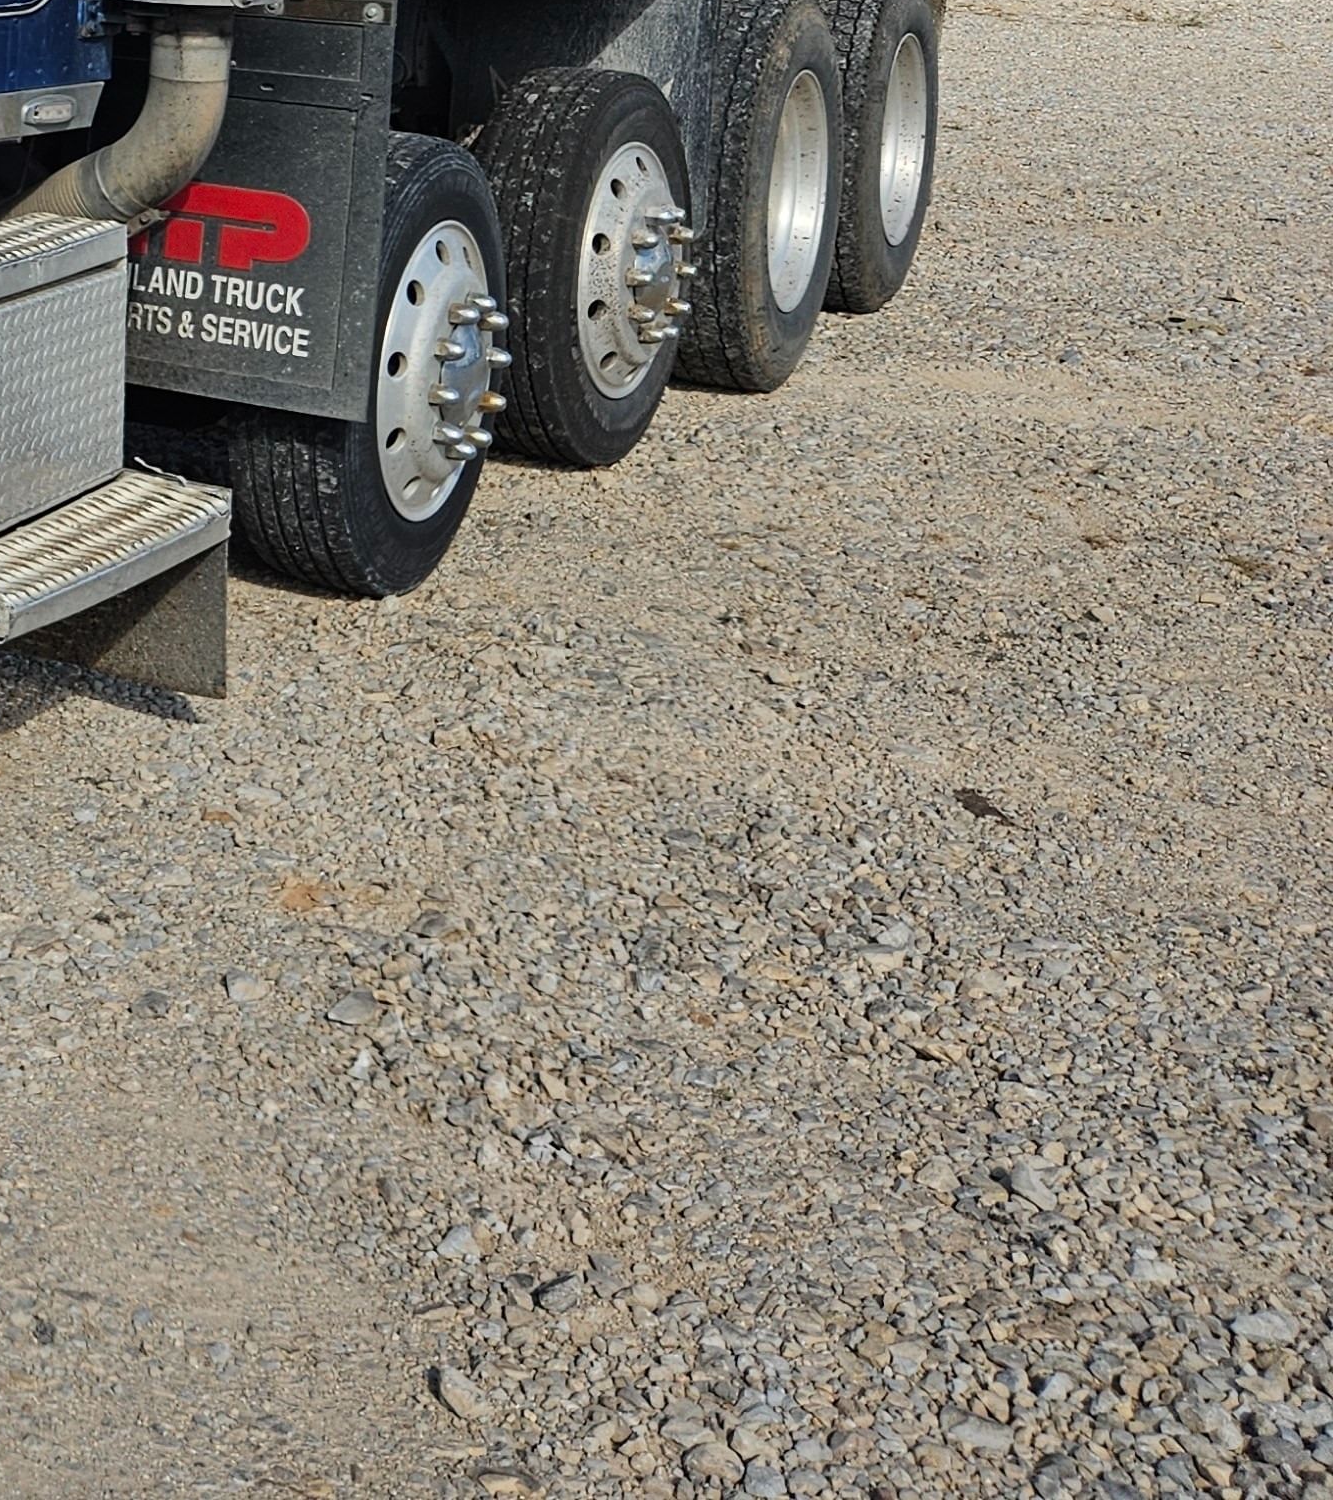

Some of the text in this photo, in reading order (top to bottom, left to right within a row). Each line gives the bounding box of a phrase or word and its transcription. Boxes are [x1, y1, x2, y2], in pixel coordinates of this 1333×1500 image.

[128, 263, 305, 317] LAND TRUCK
[177, 310, 194, 339] &
[200, 313, 311, 358] SERVICE
